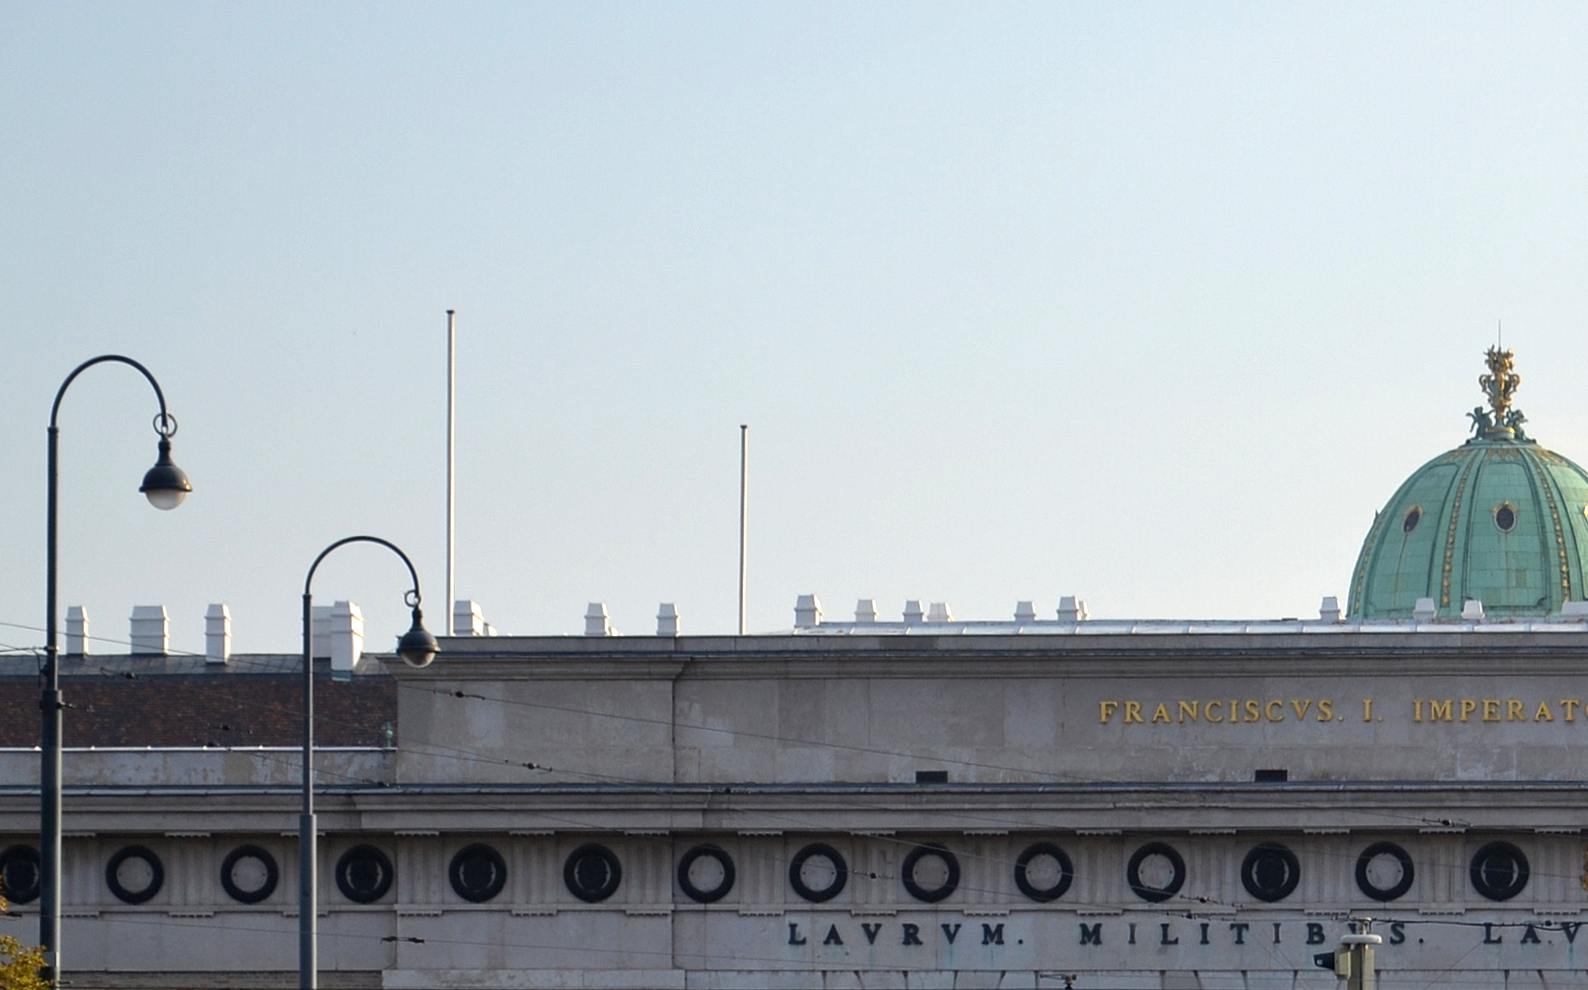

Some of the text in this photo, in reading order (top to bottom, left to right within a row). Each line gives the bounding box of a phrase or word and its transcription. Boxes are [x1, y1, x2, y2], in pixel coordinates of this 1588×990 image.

[1099, 700, 1343, 723] FRANCISCVS.
[1362, 700, 1384, 723] I.
[788, 923, 1024, 945] LAVRVM.
